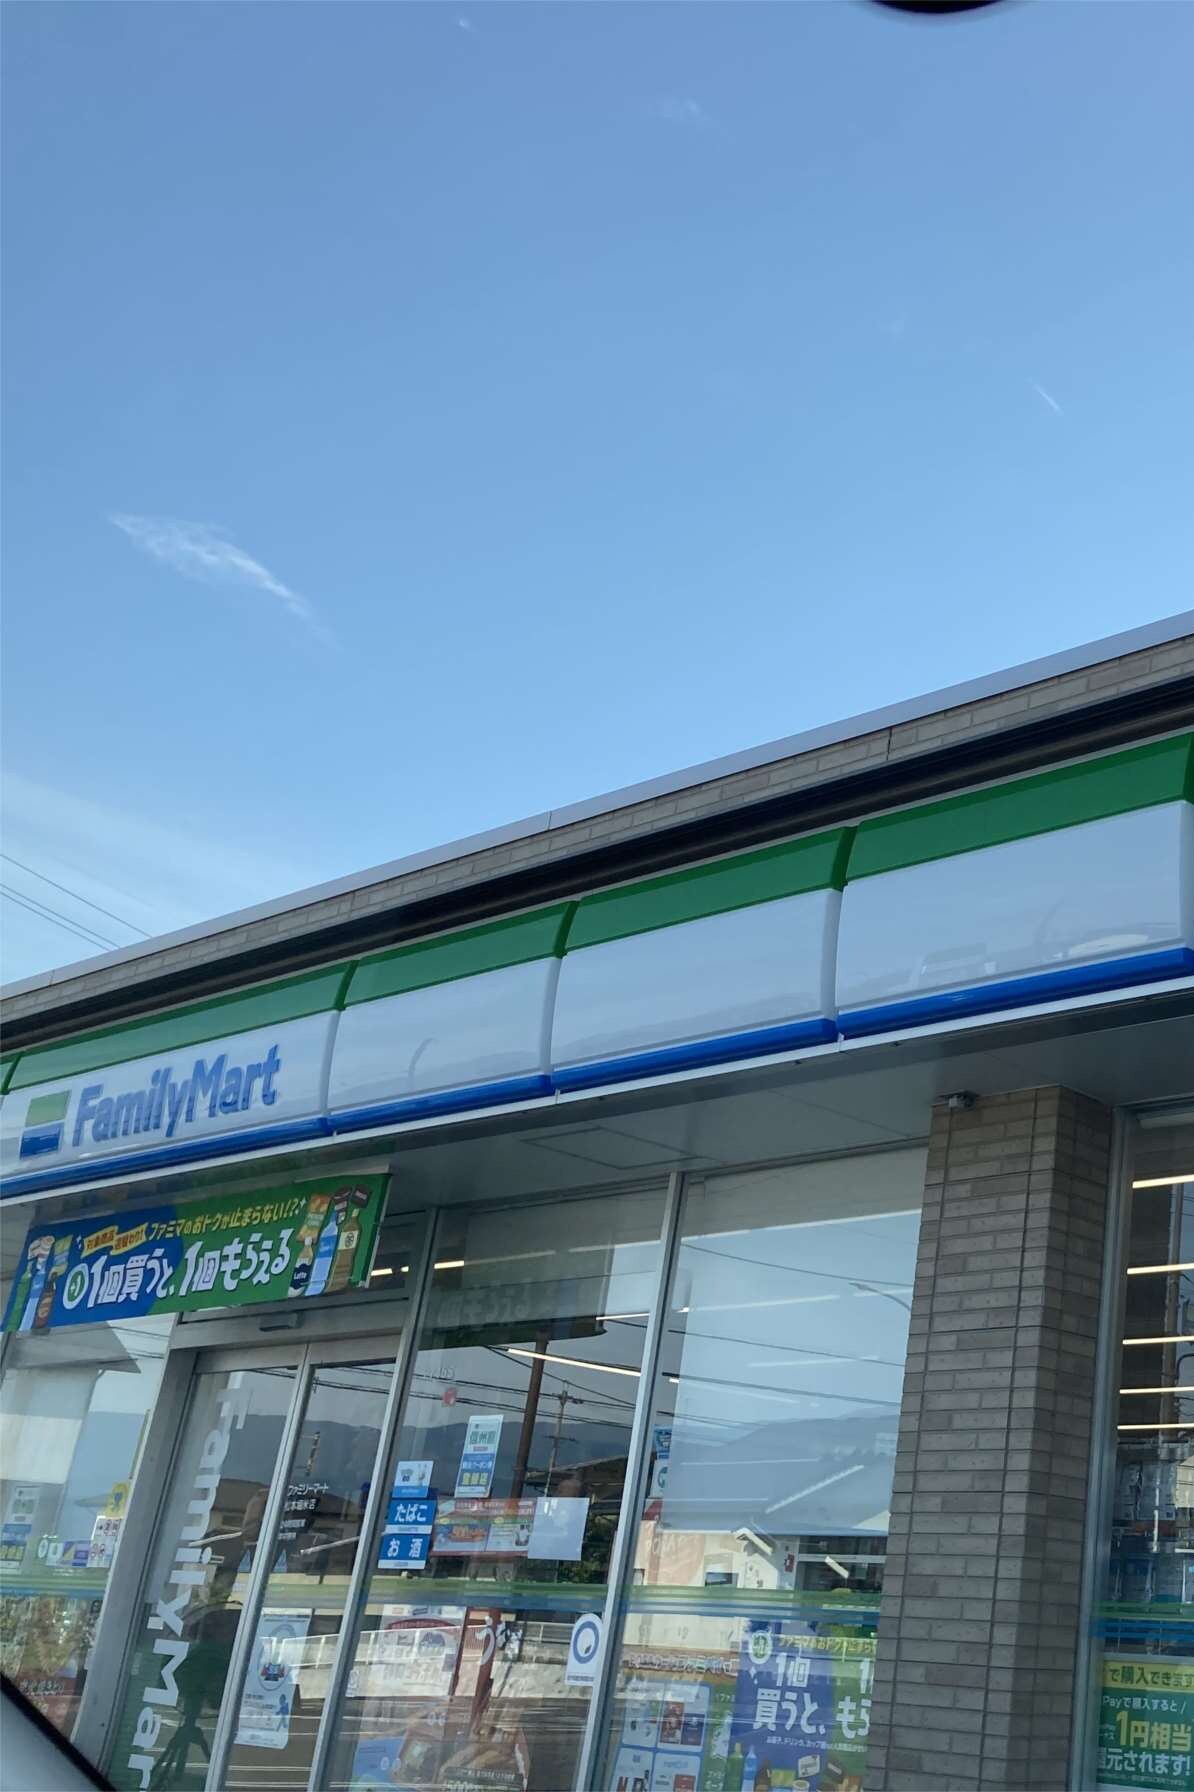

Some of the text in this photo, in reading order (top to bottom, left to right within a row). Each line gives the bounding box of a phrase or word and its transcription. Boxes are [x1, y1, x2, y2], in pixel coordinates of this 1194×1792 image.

[72, 1043, 281, 1147] FamilyMart
[394, 1503, 428, 1522] たばこ
[127, 1386, 253, 1792] FamilyMar
[776, 1652, 810, 1687] 1個
[753, 1688, 826, 1735] 買うと、
[1116, 1710, 1192, 1752] 1円相当
